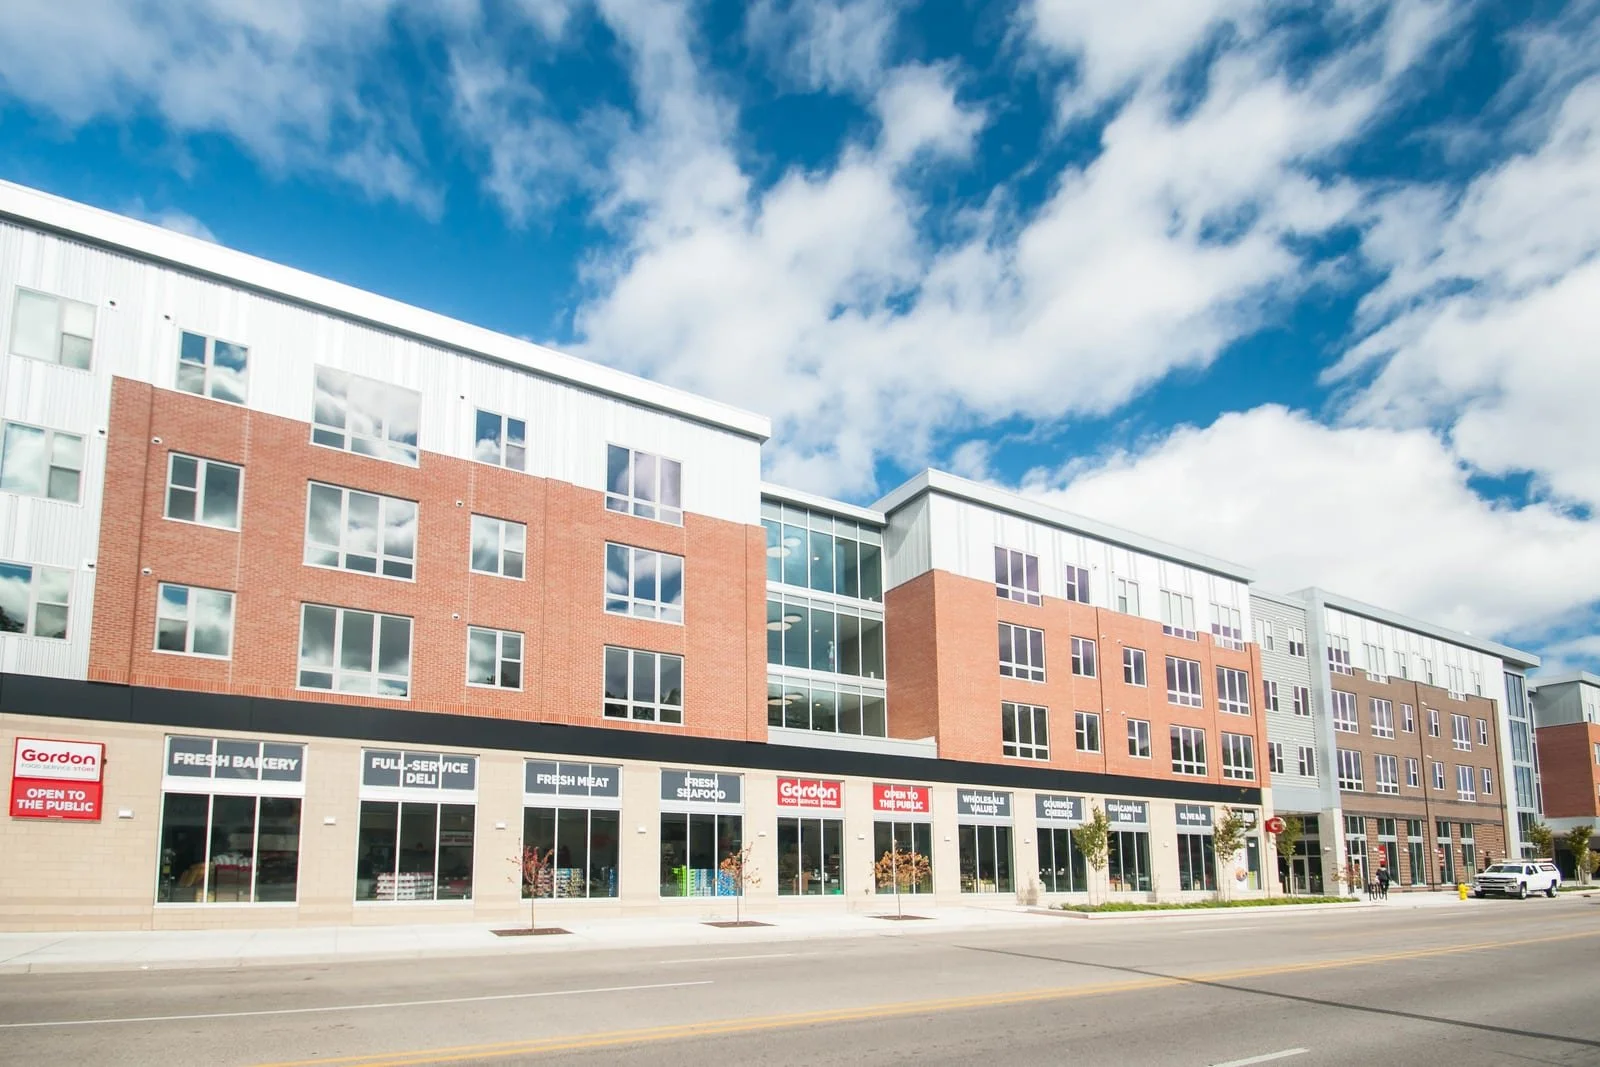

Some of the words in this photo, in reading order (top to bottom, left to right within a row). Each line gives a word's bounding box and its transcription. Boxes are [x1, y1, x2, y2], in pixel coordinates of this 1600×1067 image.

[21, 749, 96, 765] Gordon
[173, 752, 229, 767] FRESH
[232, 755, 299, 771] BAKERY
[43, 763, 72, 771] SERVICE
[372, 757, 469, 774] FULL-SERVICE
[406, 773, 436, 785] DELI
[536, 774, 576, 786] FRESH
[577, 776, 609, 788] MEAT
[684, 777, 719, 789] FRESH
[26, 788, 65, 799] OPEN
[67, 790, 86, 800] TO
[676, 787, 726, 799] SEAFOOD
[780, 782, 837, 799] Gordon
[884, 790, 906, 799] OPEN
[907, 791, 919, 800] TO
[16, 799, 44, 809] THE
[46, 801, 94, 812] PUBLIC
[879, 799, 896, 808] THE
[896, 800, 924, 810] PUBLIC
[962, 794, 1005, 805] WHOLESALE
[1043, 800, 1074, 809] GOURMET
[970, 804, 998, 813] VALUES
[1045, 808, 1073, 817] CHEESES
[1108, 804, 1142, 813] GUCAMOLE
[1120, 812, 1132, 820] BAR
